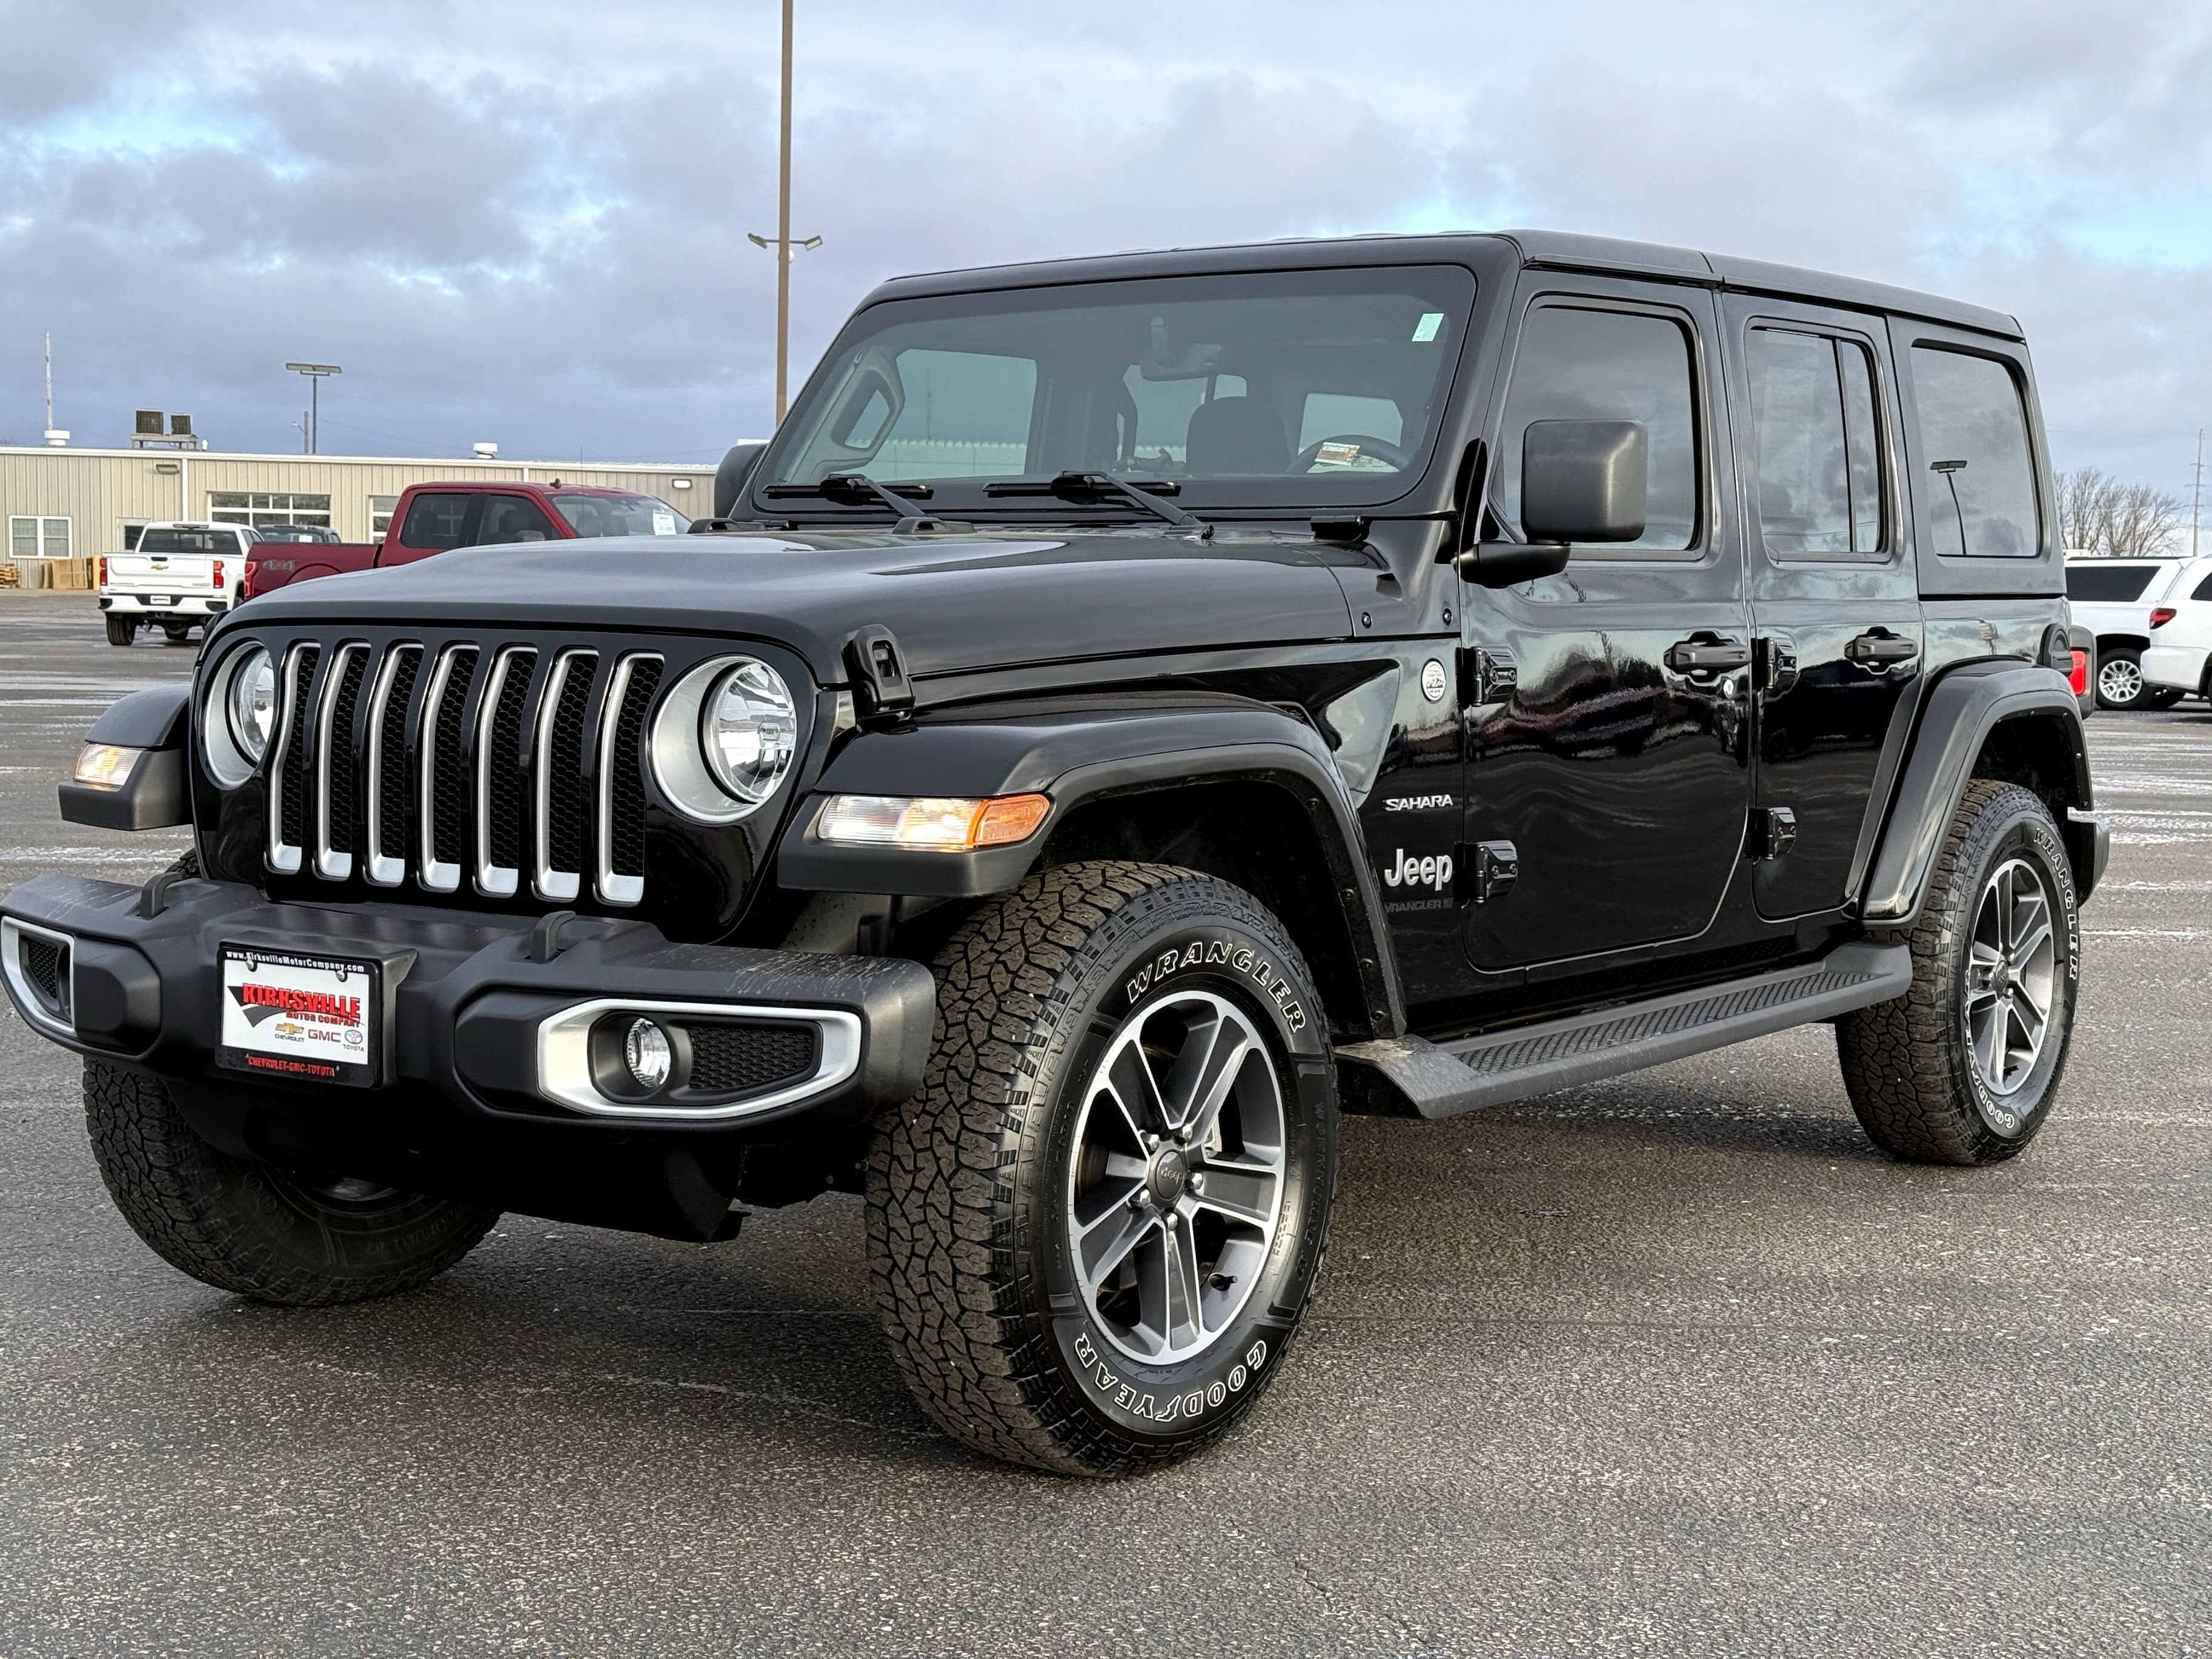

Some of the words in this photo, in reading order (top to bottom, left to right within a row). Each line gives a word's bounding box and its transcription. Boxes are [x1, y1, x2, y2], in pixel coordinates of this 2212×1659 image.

[1384, 794, 1453, 811] SAHARA
[1384, 848, 1453, 891] Jeep
[1384, 899, 1441, 913] WRANGLER
[2033, 828, 2078, 980] WRANGLER
[226, 951, 365, 972] www.KirksvilleMotorCompany.com
[1127, 941, 1306, 1033] WRANGLER
[243, 983, 360, 1019] KIRKSVILLE
[286, 1011, 316, 1022] MOTOR
[318, 1016, 360, 1028] COMPANY
[274, 1034, 304, 1043] CHEVROLET
[308, 1029, 341, 1043] GMC
[343, 1043, 365, 1052] TOYOTA
[1075, 1332, 1267, 1422] GOODYEAR
